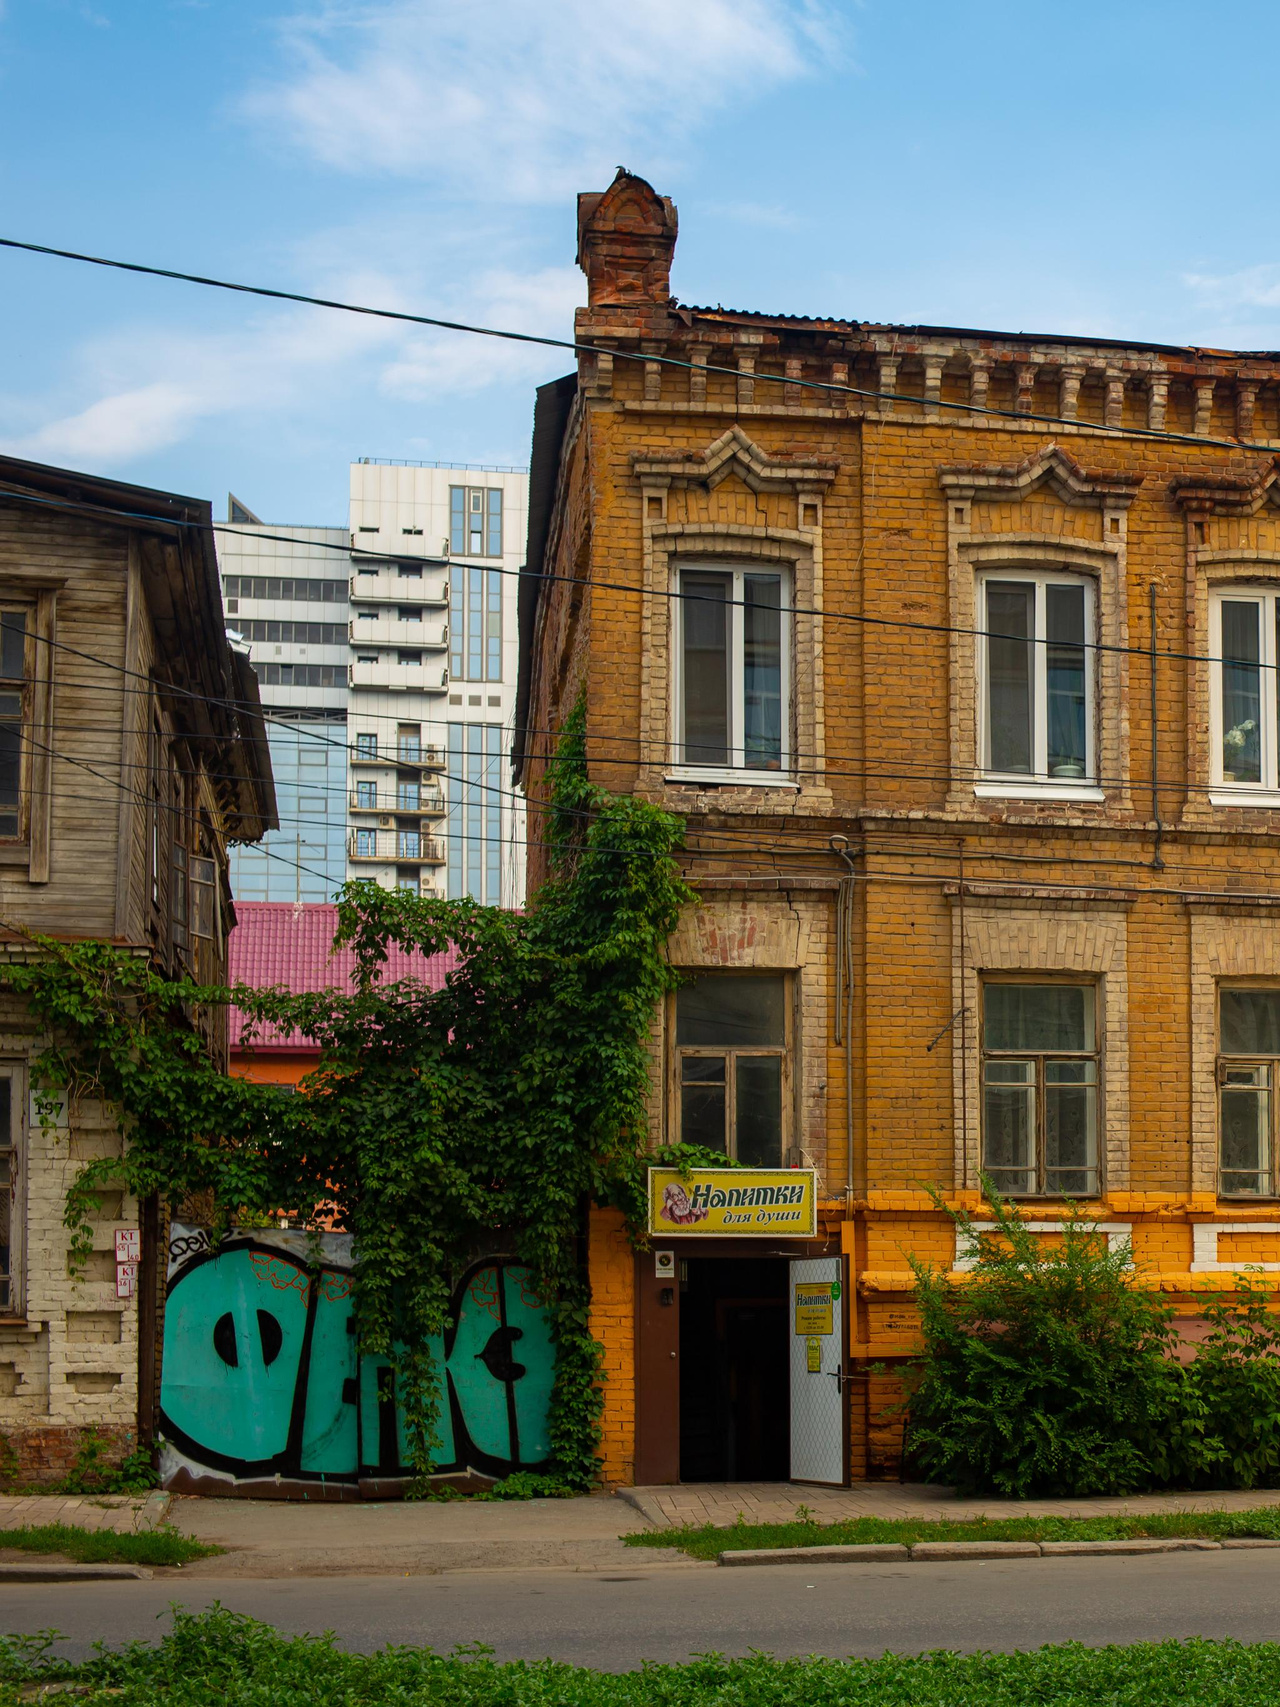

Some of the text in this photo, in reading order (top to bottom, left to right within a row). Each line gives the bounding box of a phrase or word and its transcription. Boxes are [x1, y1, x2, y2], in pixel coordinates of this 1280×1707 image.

[691, 1184, 804, 1209] Напитки
[723, 1210, 802, 1226] для души
